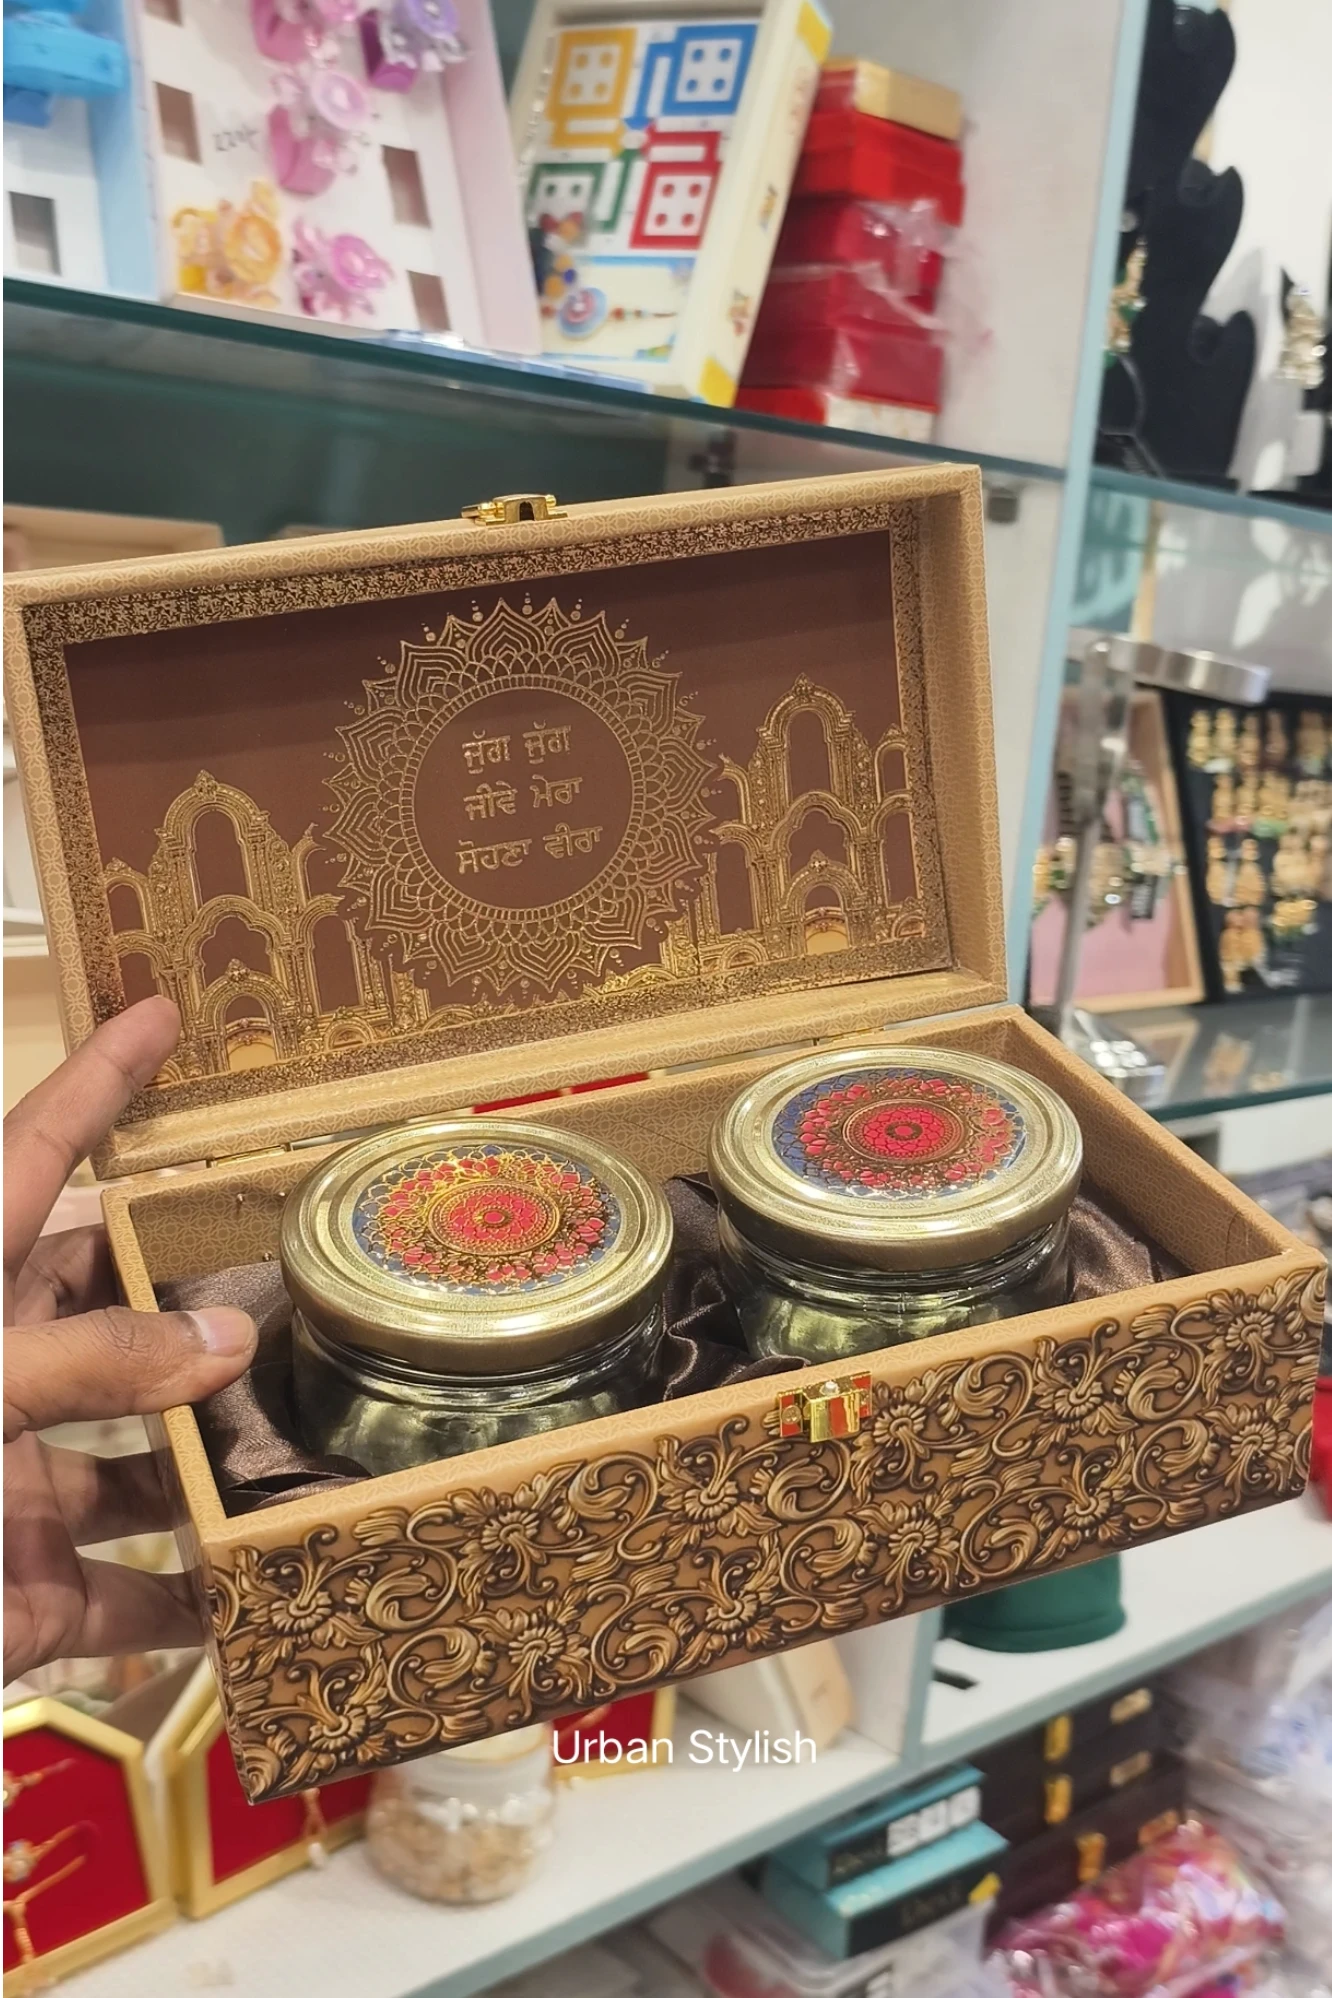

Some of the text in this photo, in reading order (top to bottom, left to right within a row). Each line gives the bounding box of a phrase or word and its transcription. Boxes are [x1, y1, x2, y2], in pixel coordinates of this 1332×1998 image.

[463, 774, 583, 820] ਜੀਵੇ ਮੇਰਾ
[455, 822, 603, 874] ਸੋਹਣਾ ਵੀਰਾ
